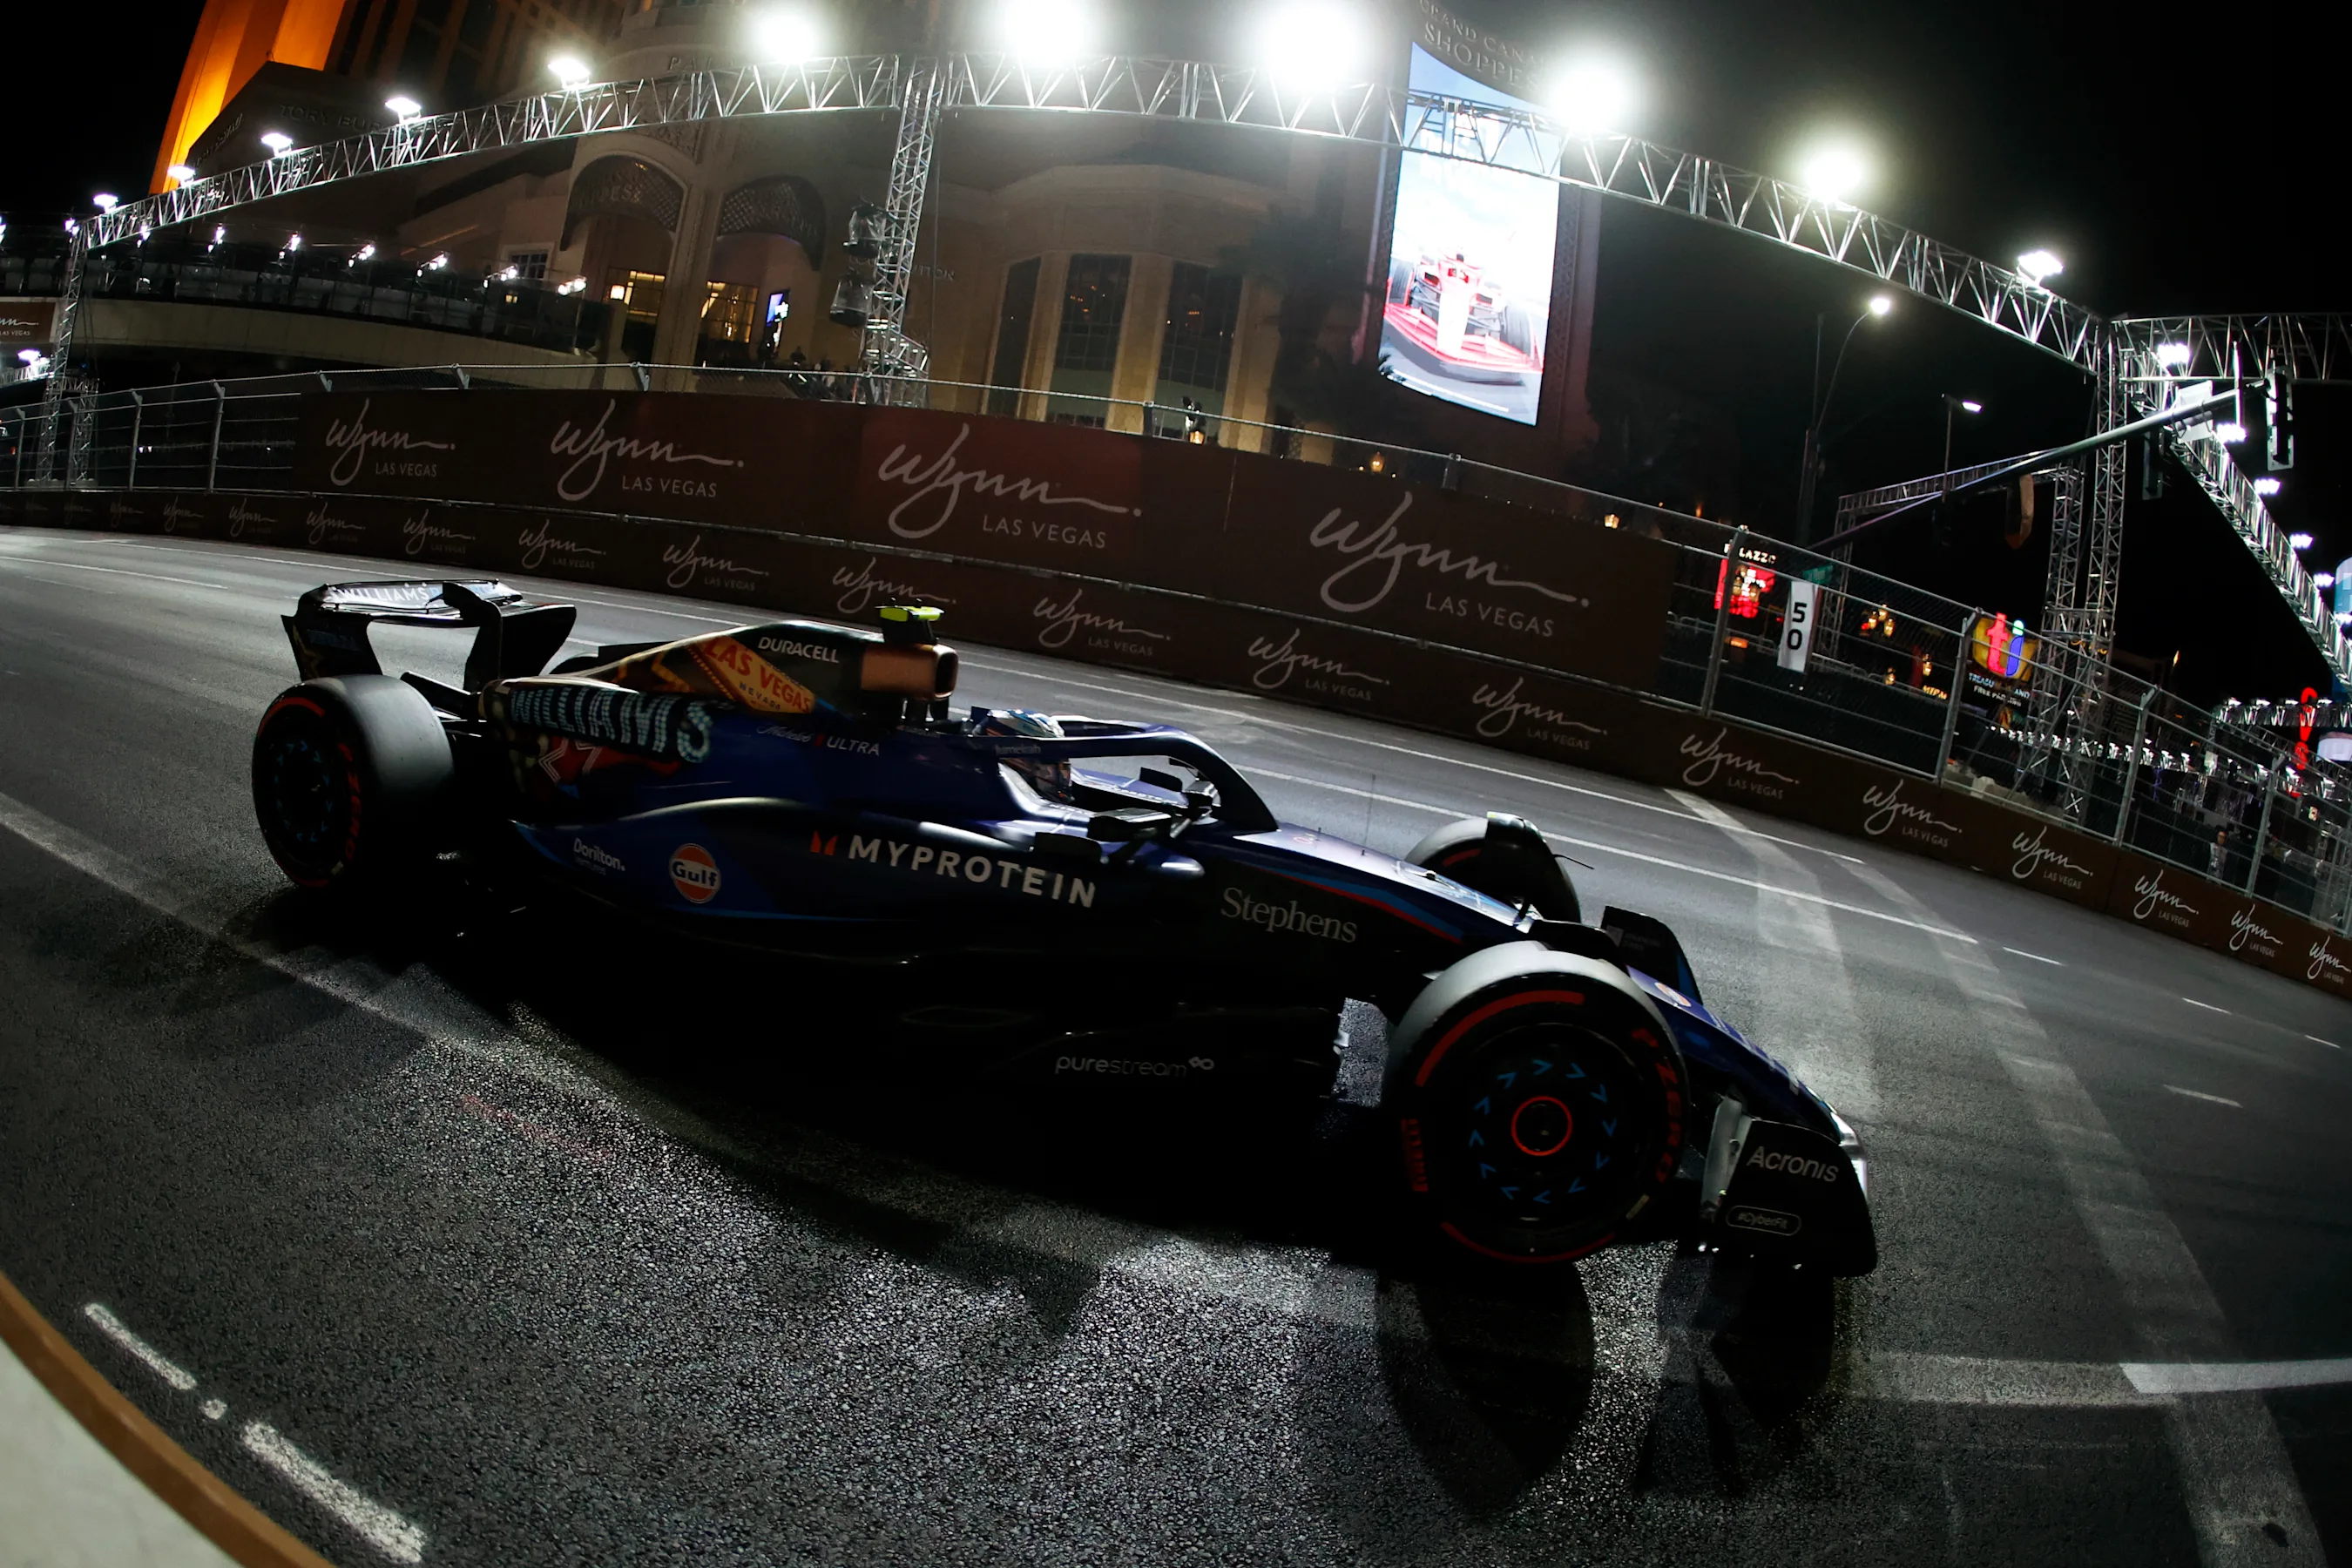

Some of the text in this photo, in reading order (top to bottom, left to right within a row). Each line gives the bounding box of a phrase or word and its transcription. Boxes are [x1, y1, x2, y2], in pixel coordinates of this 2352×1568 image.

[375, 462, 437, 478] LAS VEGAS
[622, 475, 718, 498] LAS VEGAS
[982, 515, 1106, 549] LAS VEGAS
[553, 558, 595, 570] LAS VEGAS
[1724, 542, 1777, 565] PLAZZO
[341, 585, 430, 604] WILLIAMS
[704, 576, 756, 592] LAS VEGAS
[1425, 591, 1555, 639] LAS VEGAS
[757, 636, 840, 664] DURACELL
[1088, 636, 1153, 658] LAS VEGAS
[704, 635, 813, 713] LAS VEGAS
[739, 680, 781, 711] NEVADA
[1305, 679, 1372, 702] LAS VEGAS
[510, 684, 713, 765] WILLIAMS
[826, 734, 882, 757] ULTRA
[1526, 728, 1592, 752] LAS VEGAS
[1727, 776, 1784, 801] LAS VEGAS
[1902, 827, 1950, 848] LAS VEGAS
[673, 862, 718, 891] Gulf
[848, 835, 1097, 909] MYPROTEIN
[2043, 869, 2082, 890] LAS VEGAS
[1220, 887, 1359, 944] Stephens
[2159, 909, 2191, 929] LAS VEGAS
[1054, 1055, 1187, 1078] purestream
[1745, 1145, 1841, 1184] Acronis
